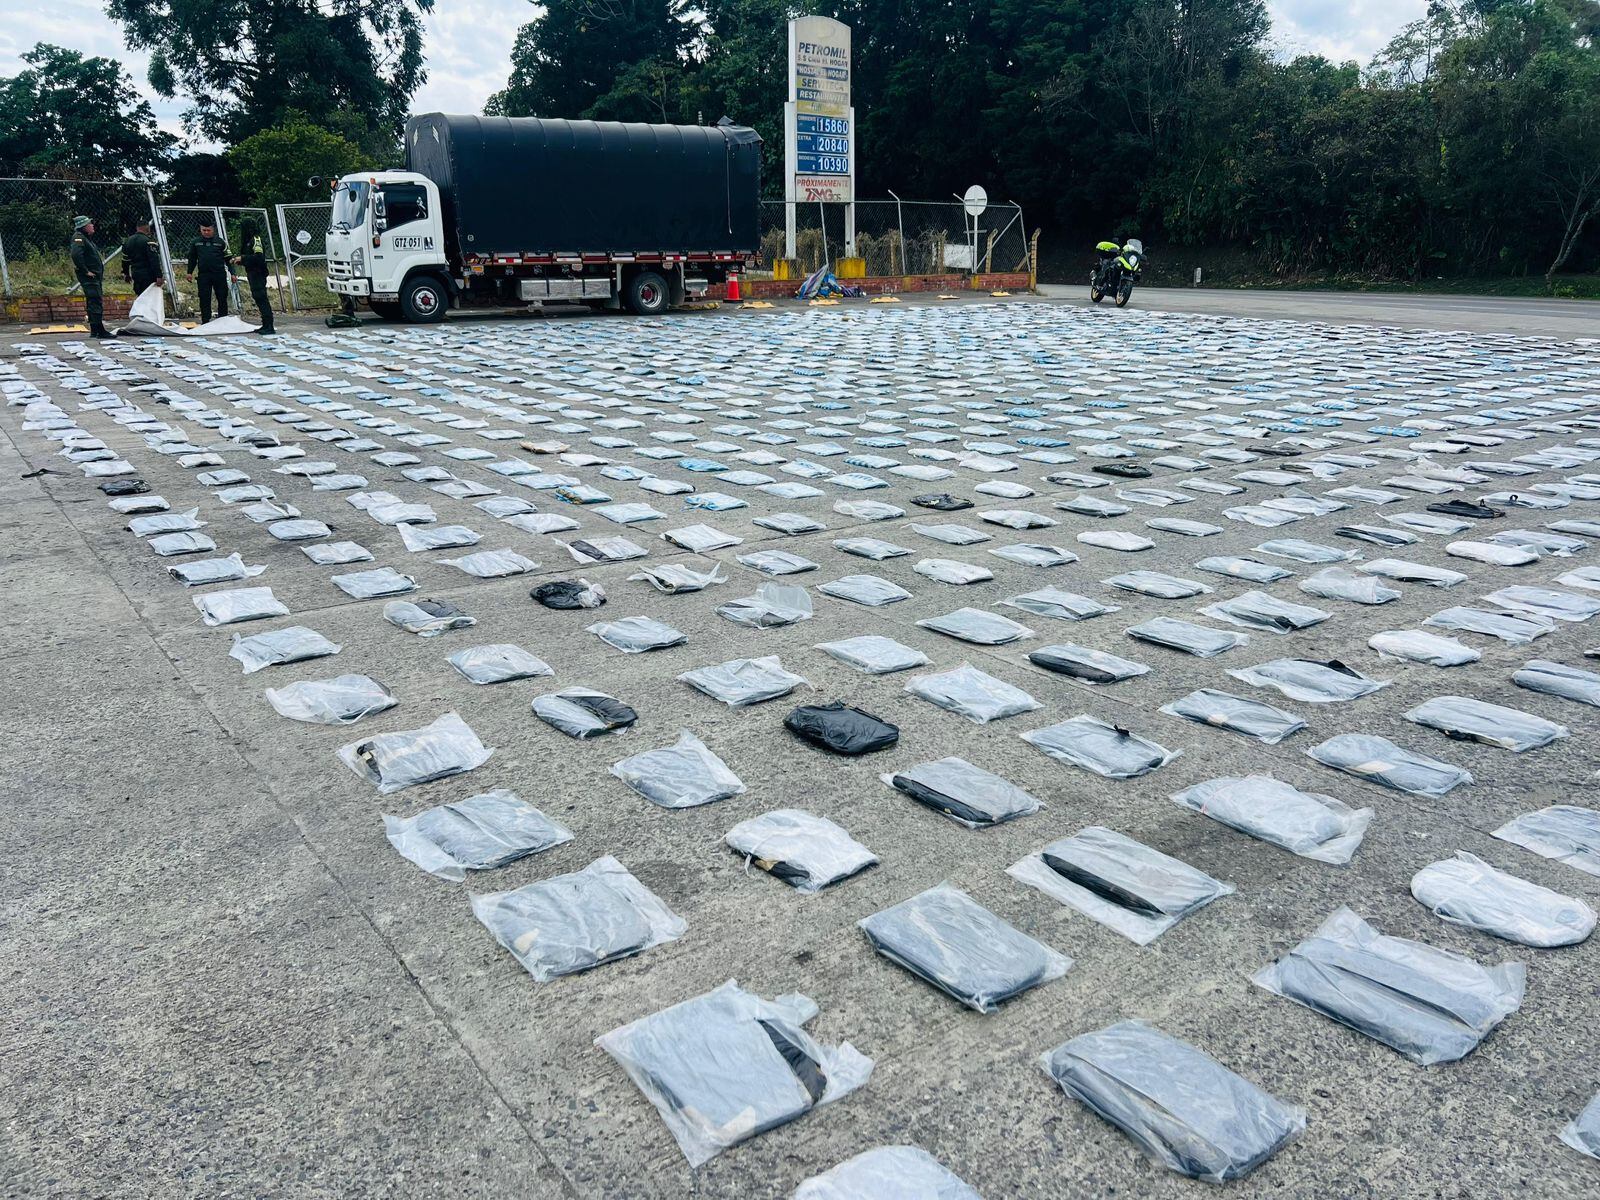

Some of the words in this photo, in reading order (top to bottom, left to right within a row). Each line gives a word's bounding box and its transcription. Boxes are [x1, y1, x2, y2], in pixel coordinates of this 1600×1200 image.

[799, 42, 847, 59] PETROMIL
[819, 118, 848, 134] 15860
[818, 138, 848, 153] 20840
[818, 157, 848, 171] 10390
[797, 178, 849, 188] PRÓXIMAMENTE
[394, 237, 421, 248] GTZ-051
